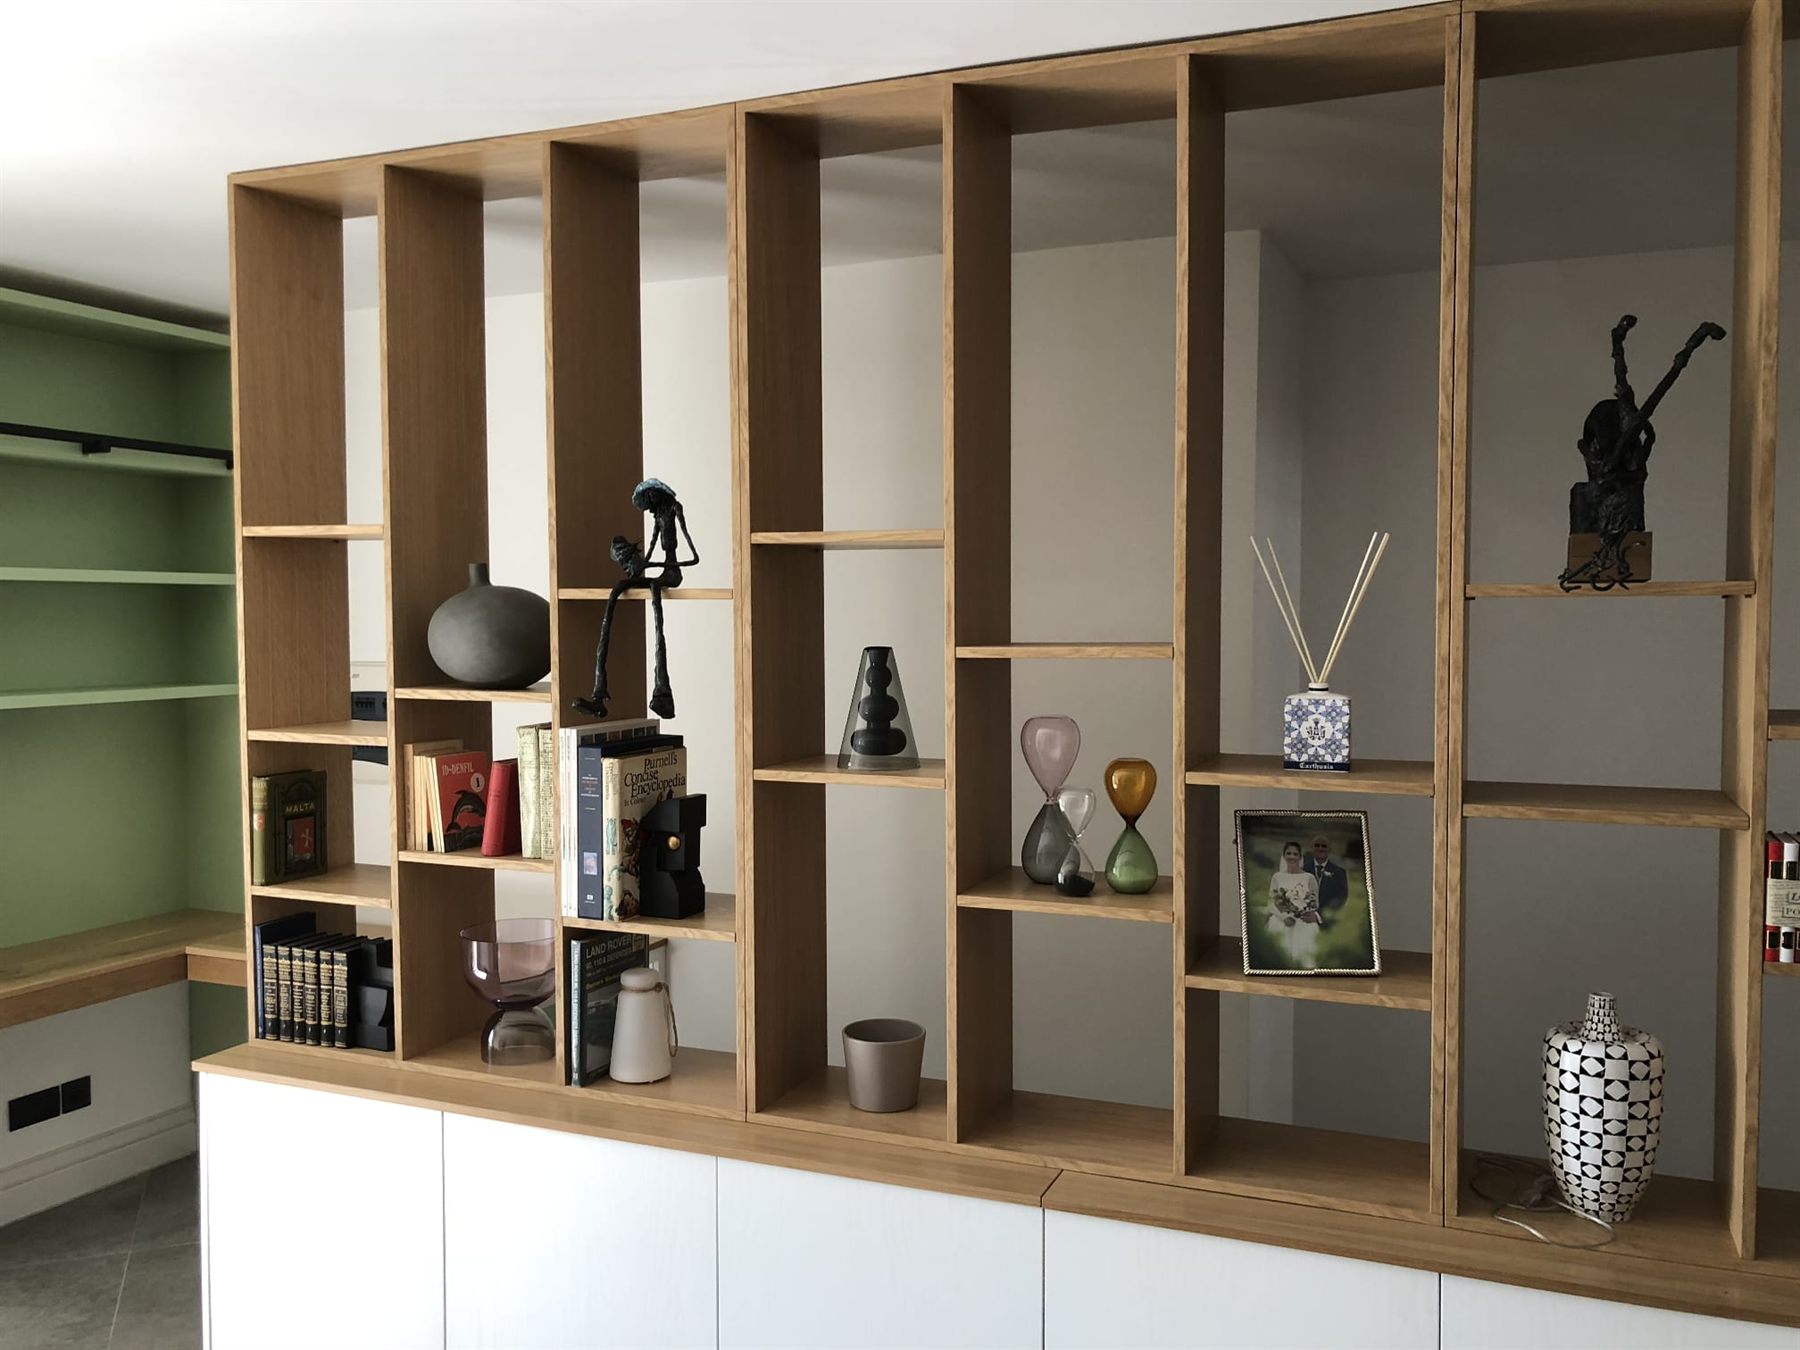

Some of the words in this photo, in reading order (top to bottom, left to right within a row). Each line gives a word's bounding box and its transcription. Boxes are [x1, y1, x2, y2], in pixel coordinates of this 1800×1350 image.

[644, 752, 678, 773] Purnell's
[475, 777, 480, 788] 1
[624, 769, 659, 787] Concise
[631, 773, 686, 798] Encyclopedia
[286, 801, 315, 813] MALTA
[586, 943, 606, 959] LAND
[607, 935, 632, 951] ROVER
